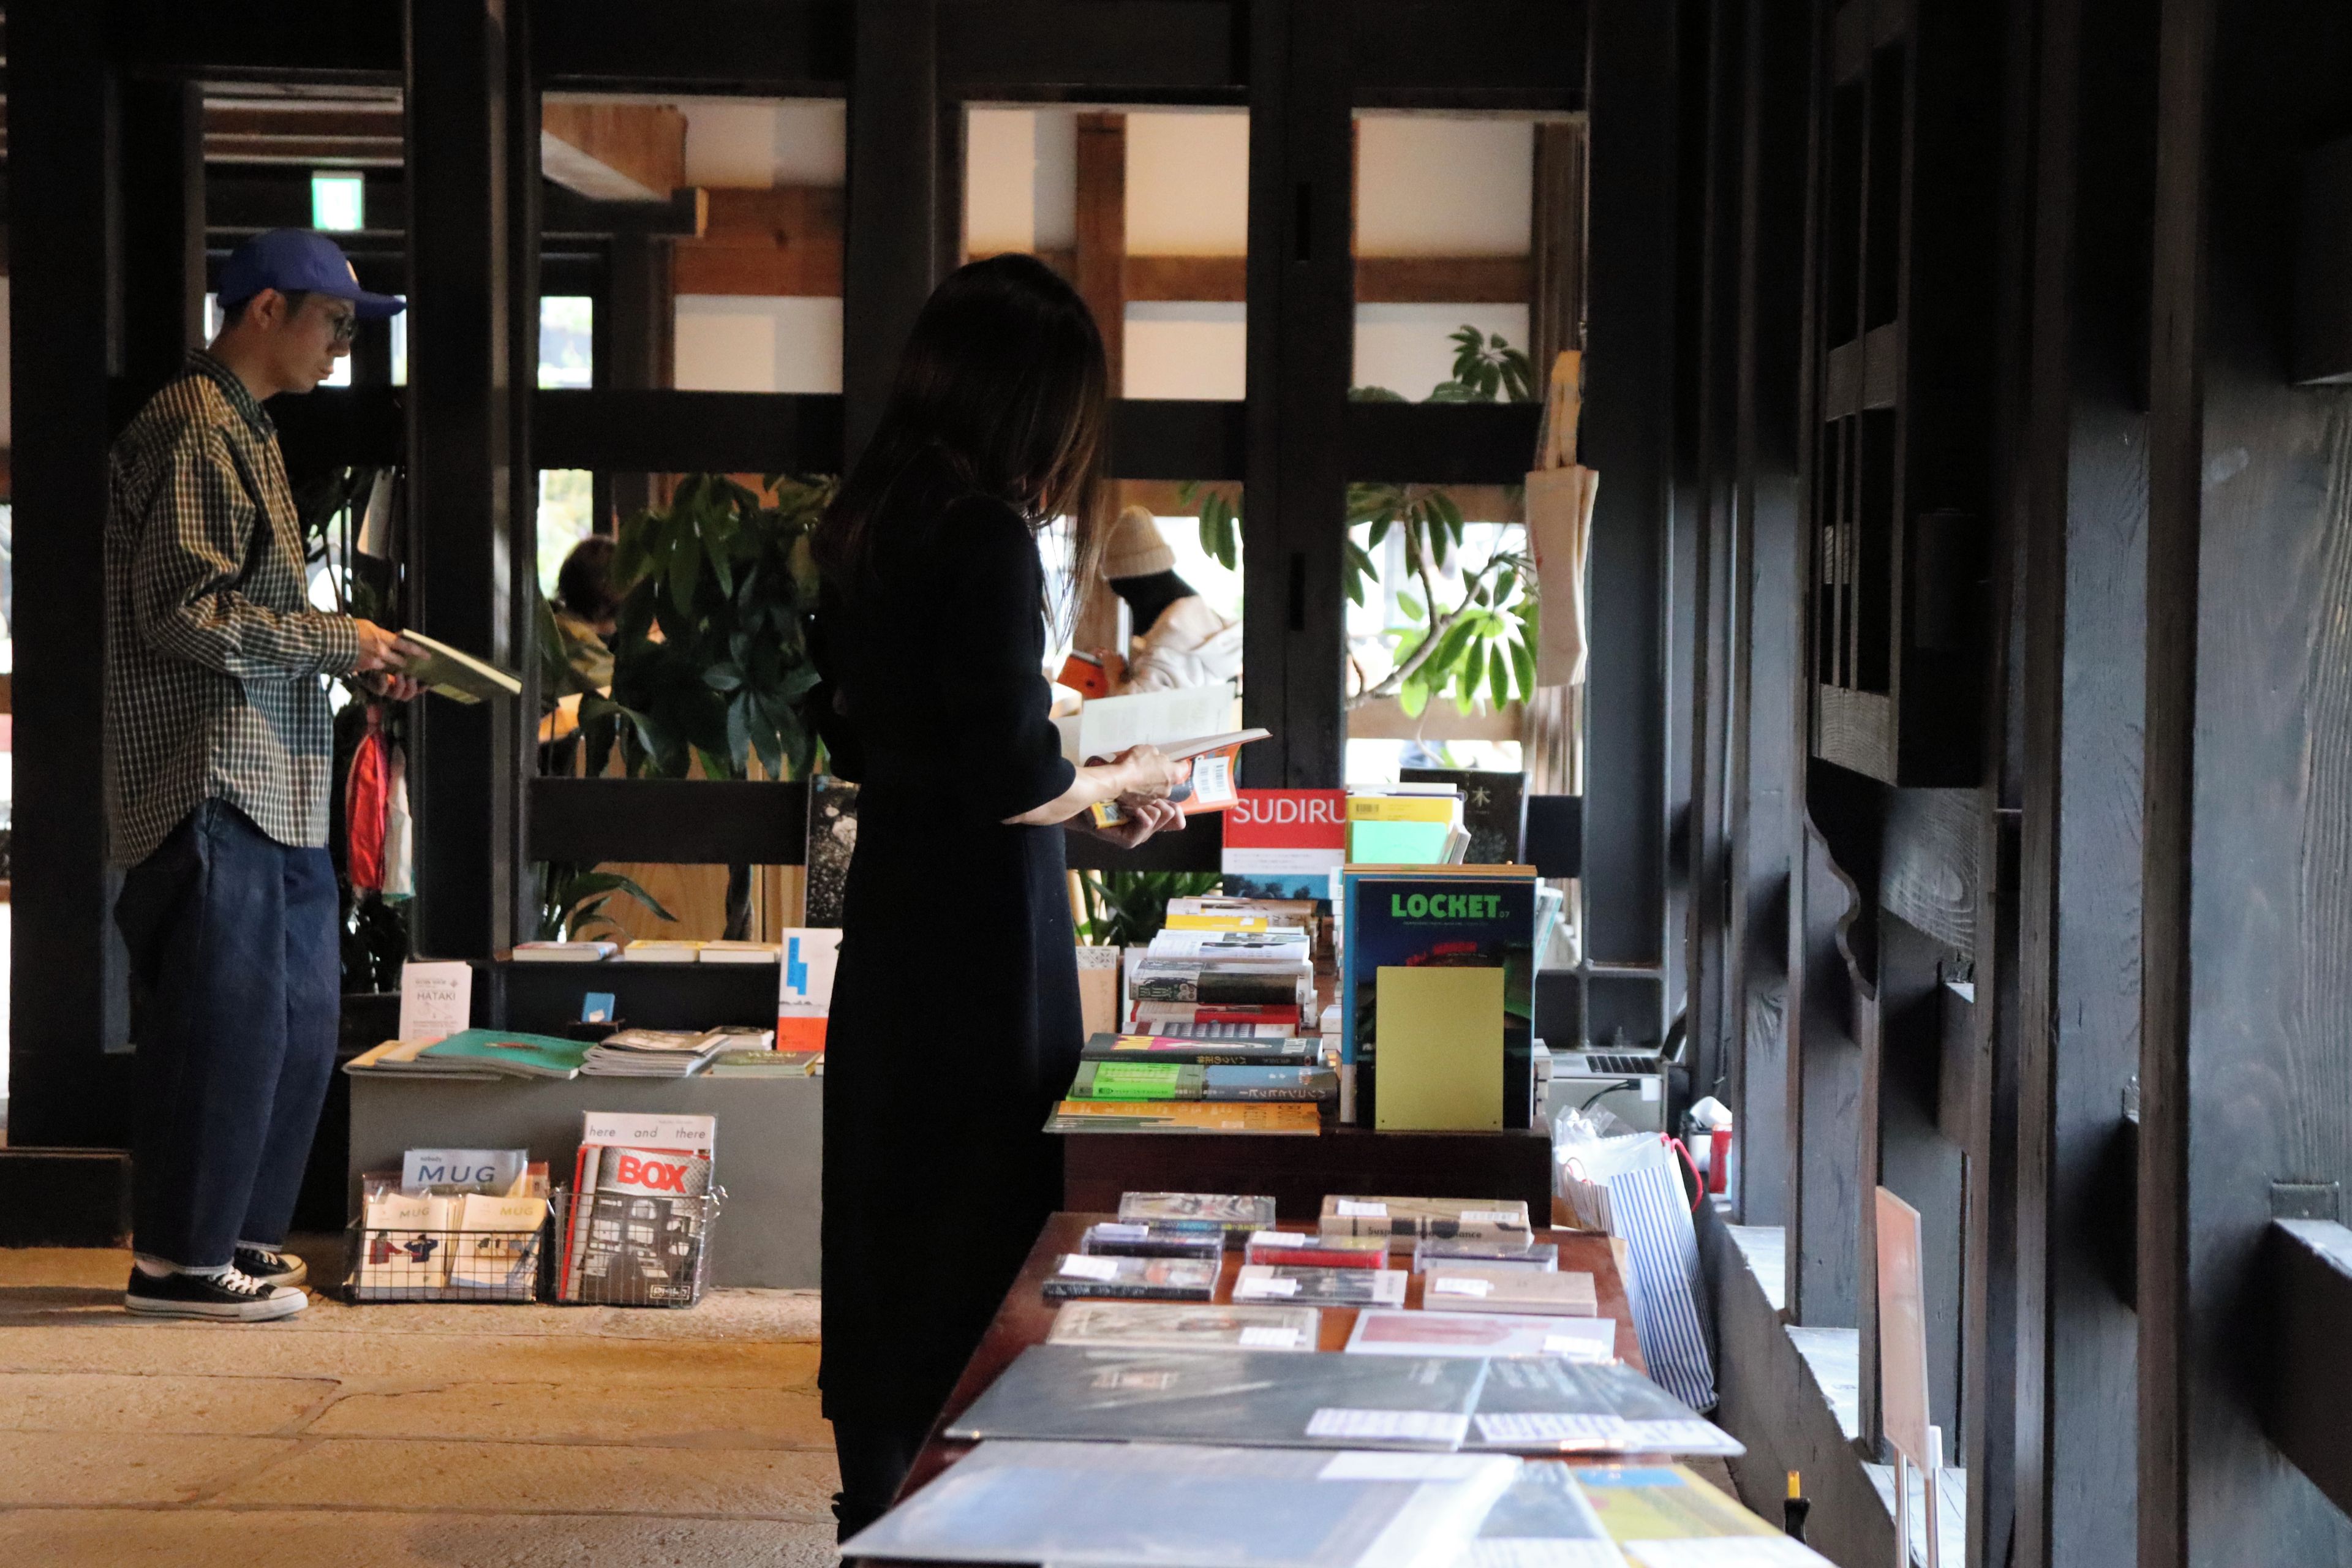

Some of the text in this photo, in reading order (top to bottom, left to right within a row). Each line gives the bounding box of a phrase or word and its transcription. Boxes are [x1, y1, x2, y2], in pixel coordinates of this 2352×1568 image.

[1391, 894, 1501, 918] LOCKET
[417, 992, 456, 1000] HATAKI
[589, 1125, 706, 1139] here and there
[418, 1165, 496, 1183] MUG
[617, 1155, 688, 1193] BOX
[399, 1207, 430, 1218] MUG
[500, 1207, 533, 1216] MUG
